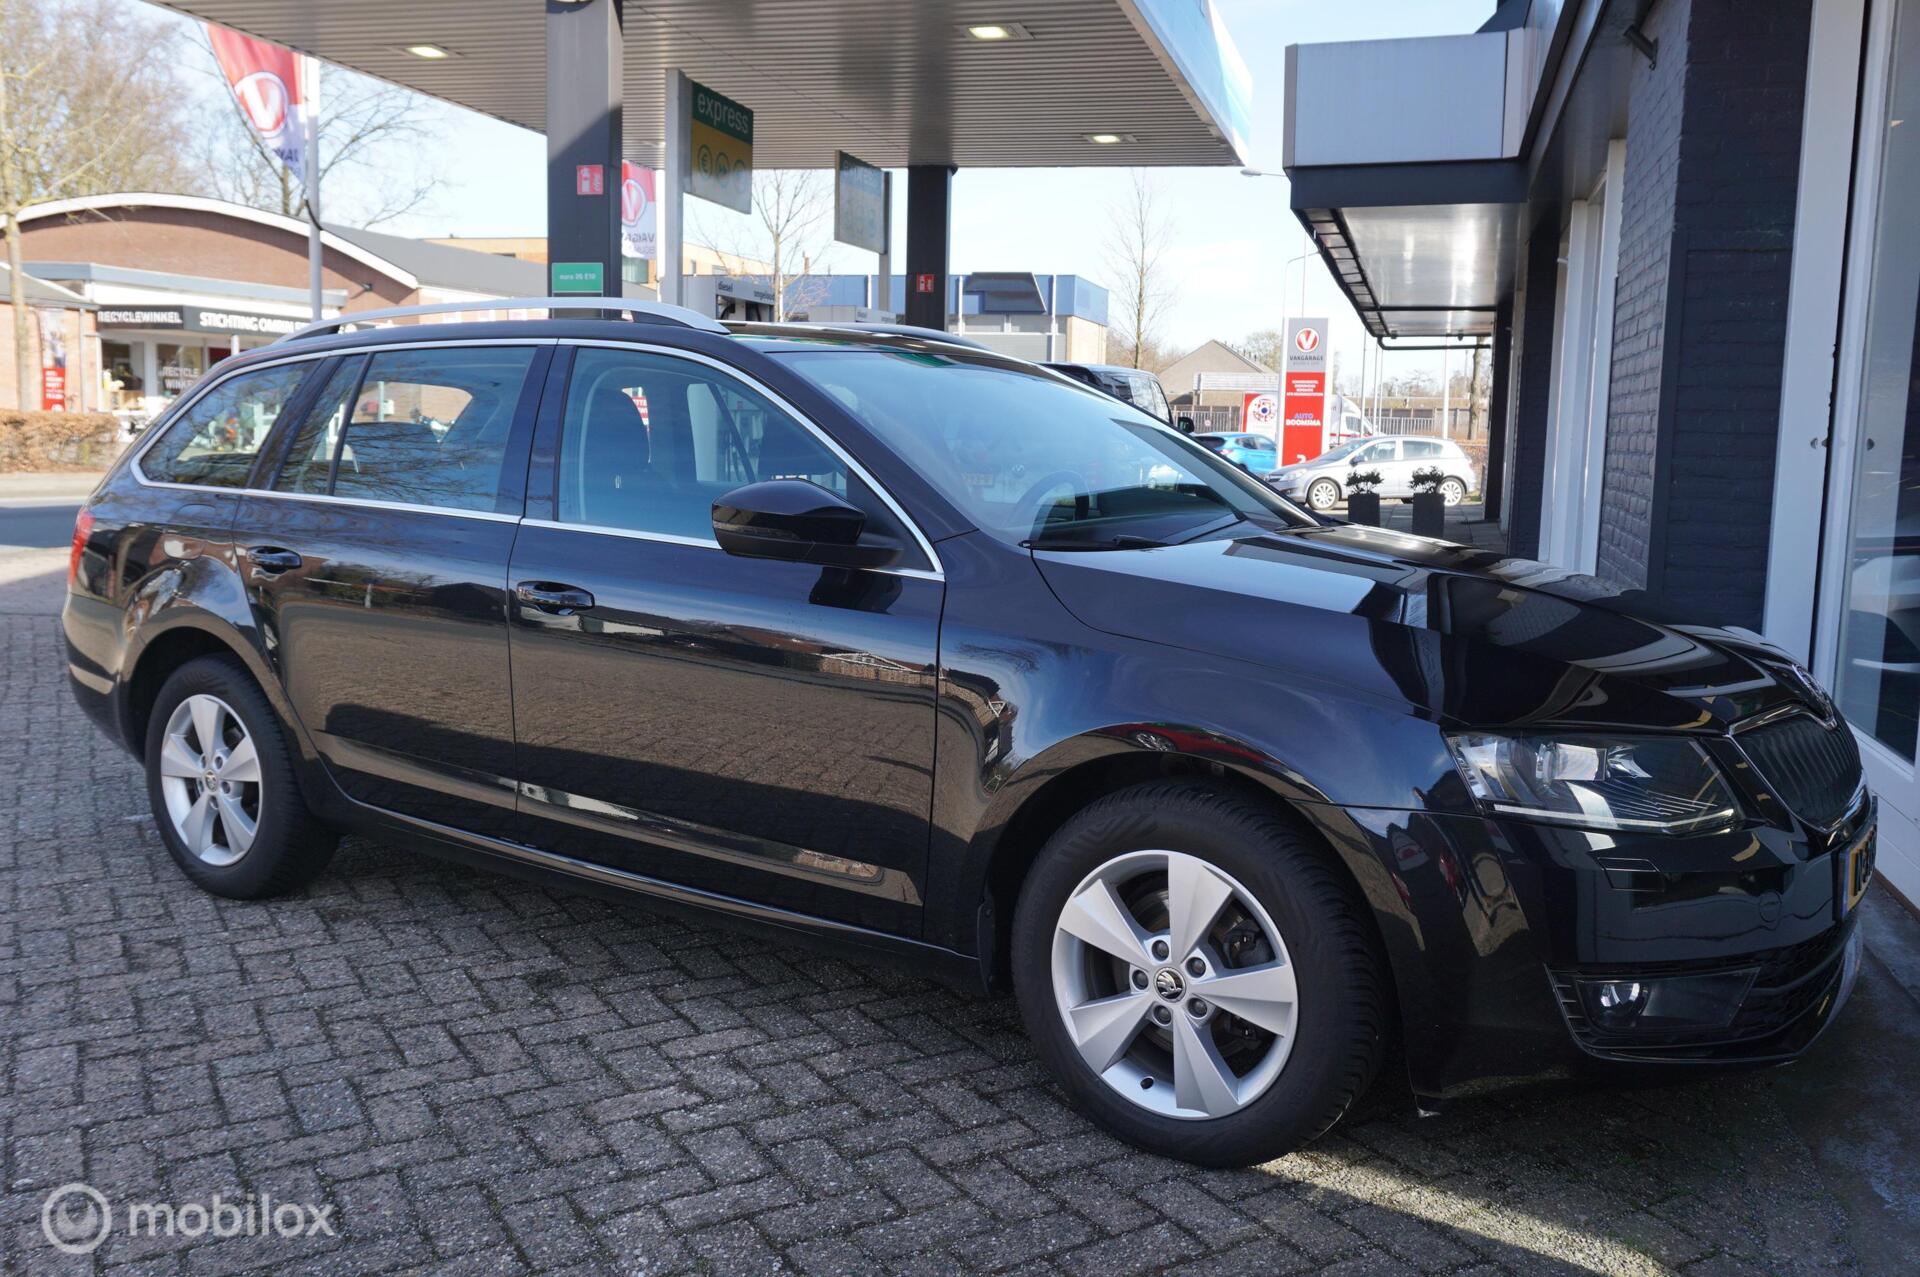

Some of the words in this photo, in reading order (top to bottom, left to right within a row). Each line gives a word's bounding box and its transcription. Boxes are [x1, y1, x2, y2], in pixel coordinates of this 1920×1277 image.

[697, 93, 748, 134] express
[97, 311, 183, 324] RECYCLEWINKEL
[199, 311, 259, 331] STICHTING
[162, 366, 199, 377] RECYCLE
